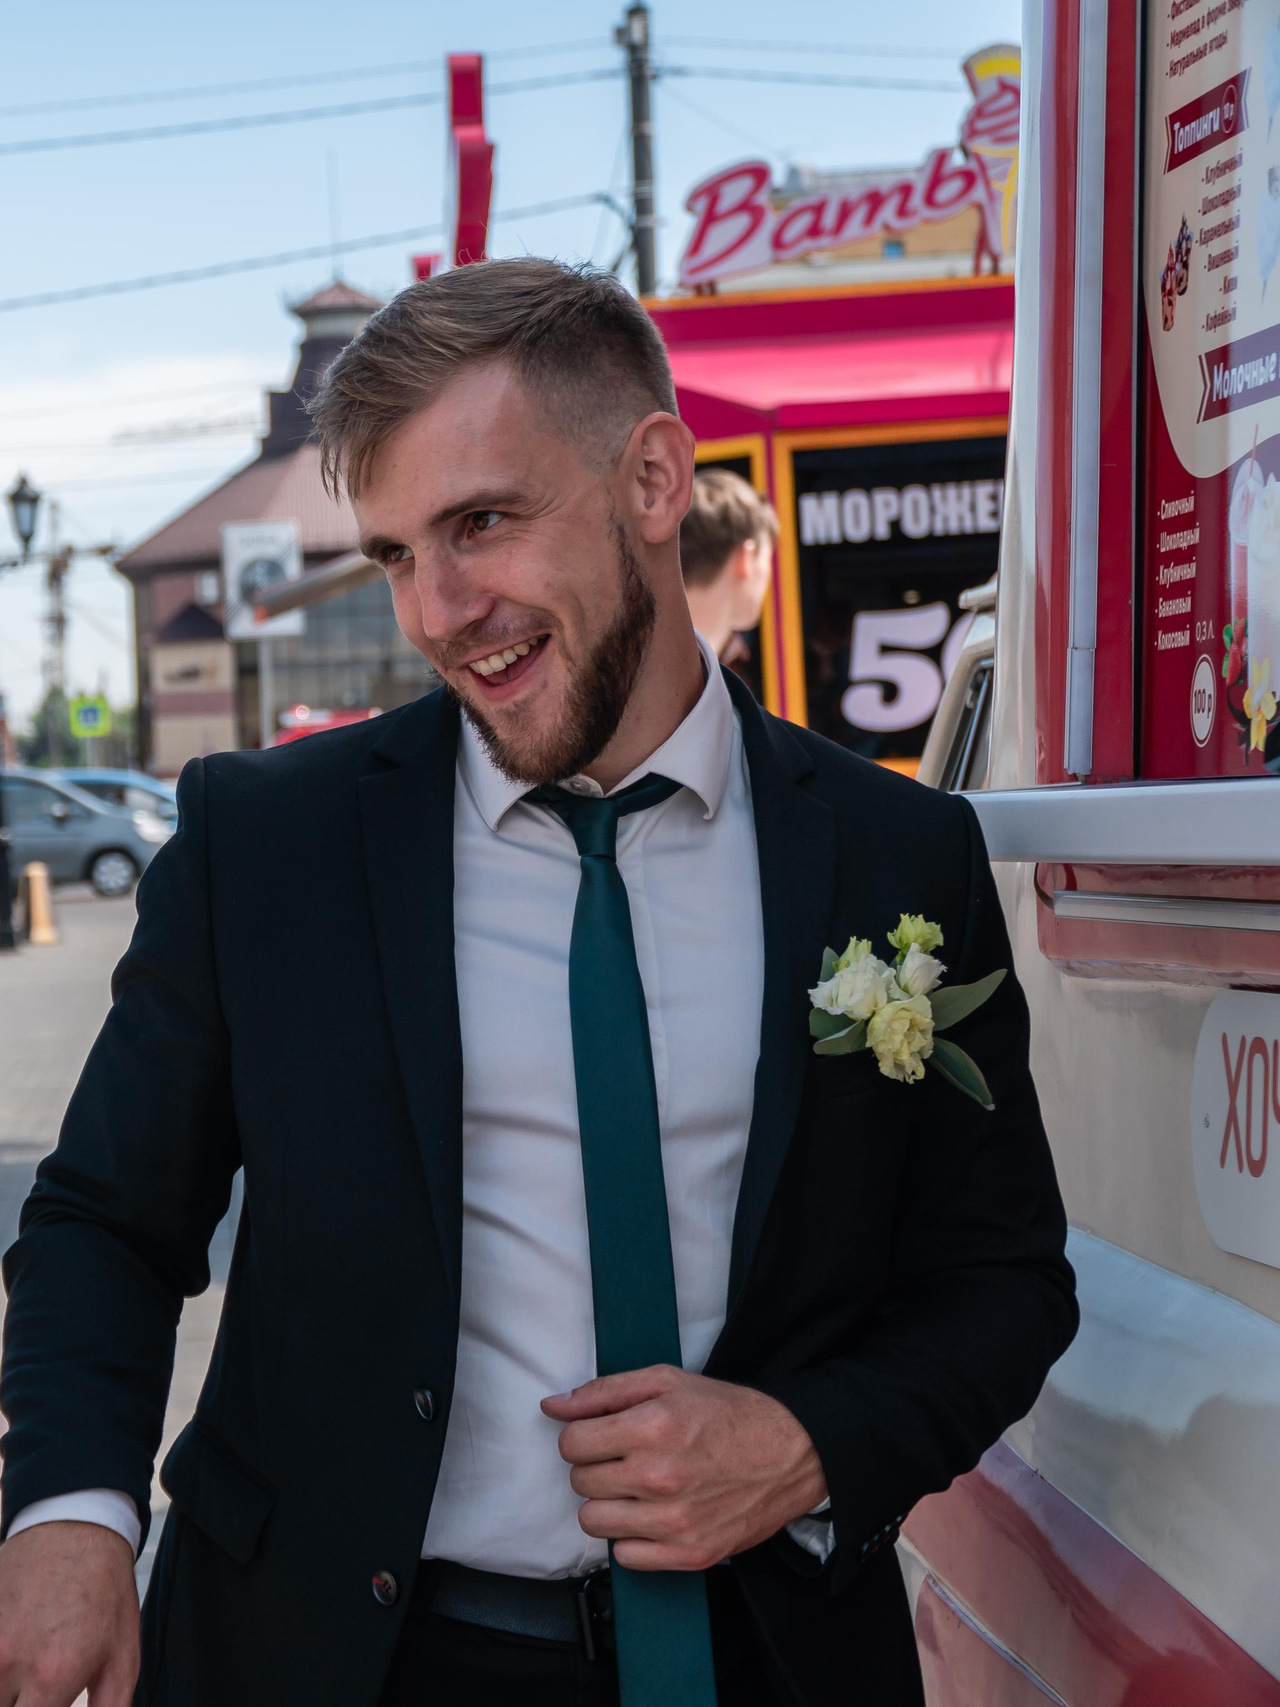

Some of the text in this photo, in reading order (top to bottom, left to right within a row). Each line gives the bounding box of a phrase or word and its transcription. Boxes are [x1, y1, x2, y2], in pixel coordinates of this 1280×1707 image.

[1173, 106, 1220, 154] Топпинги
[1212, 352, 1277, 402] Молочные
[799, 478, 1004, 547] МОРОЖЕ
[1161, 490, 1195, 520] Сливочный
[1160, 522, 1200, 553] Шоколадный
[1159, 556, 1196, 588] Клубничный
[1158, 591, 1191, 618] Банановый
[1157, 624, 1190, 651] Кокосовый
